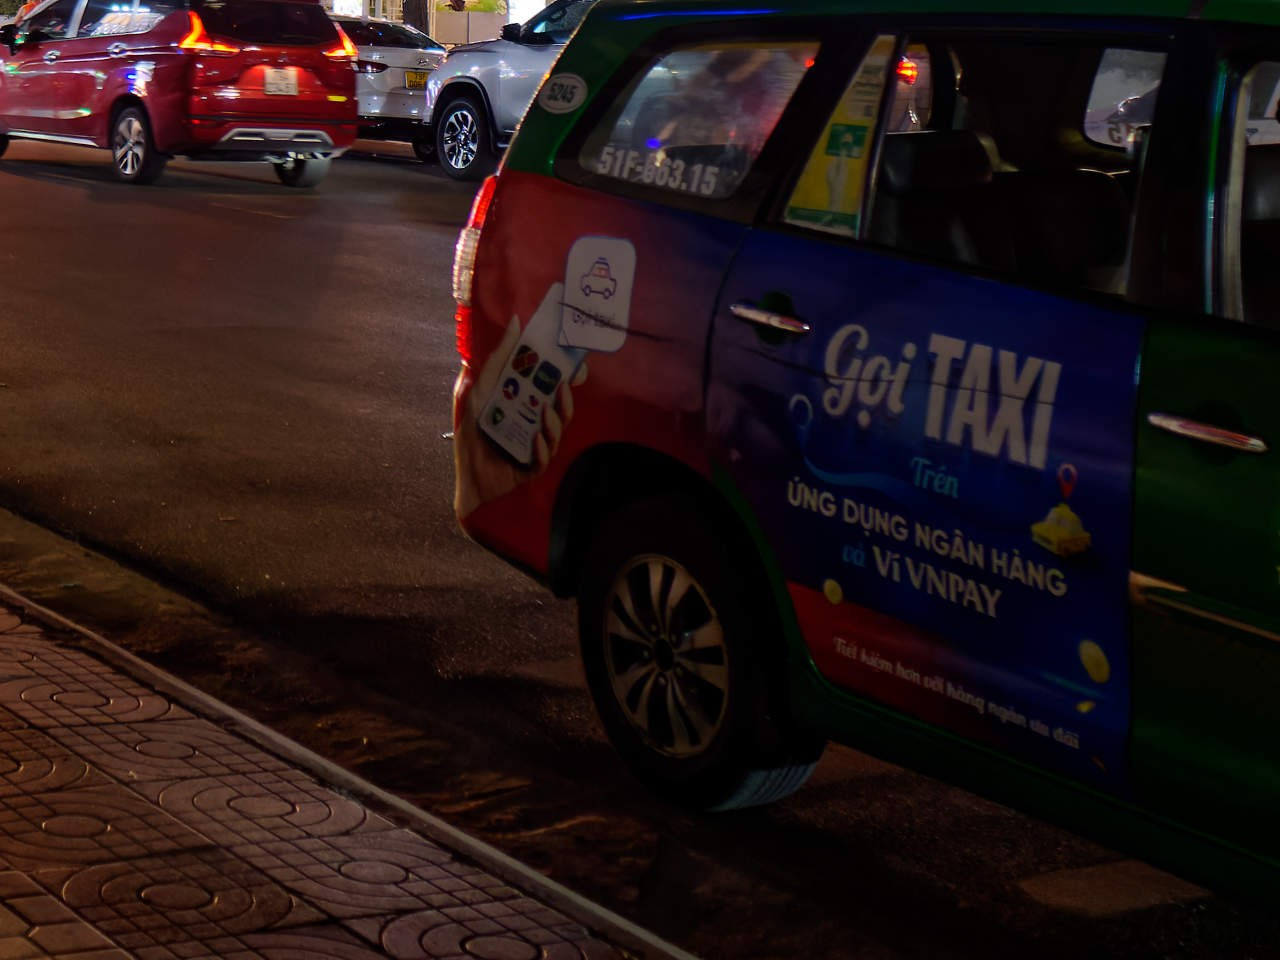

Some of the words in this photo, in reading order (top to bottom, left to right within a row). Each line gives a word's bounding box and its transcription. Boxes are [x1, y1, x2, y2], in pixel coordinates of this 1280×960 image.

[822, 323, 918, 430] Gọi
[923, 333, 1062, 471] TAXI
[787, 477, 837, 518] ỨNG
[841, 498, 909, 543] DỤNG
[914, 520, 985, 570] NGÂN
[990, 545, 1069, 597] HÀNG
[904, 557, 1005, 619] VNPAY
